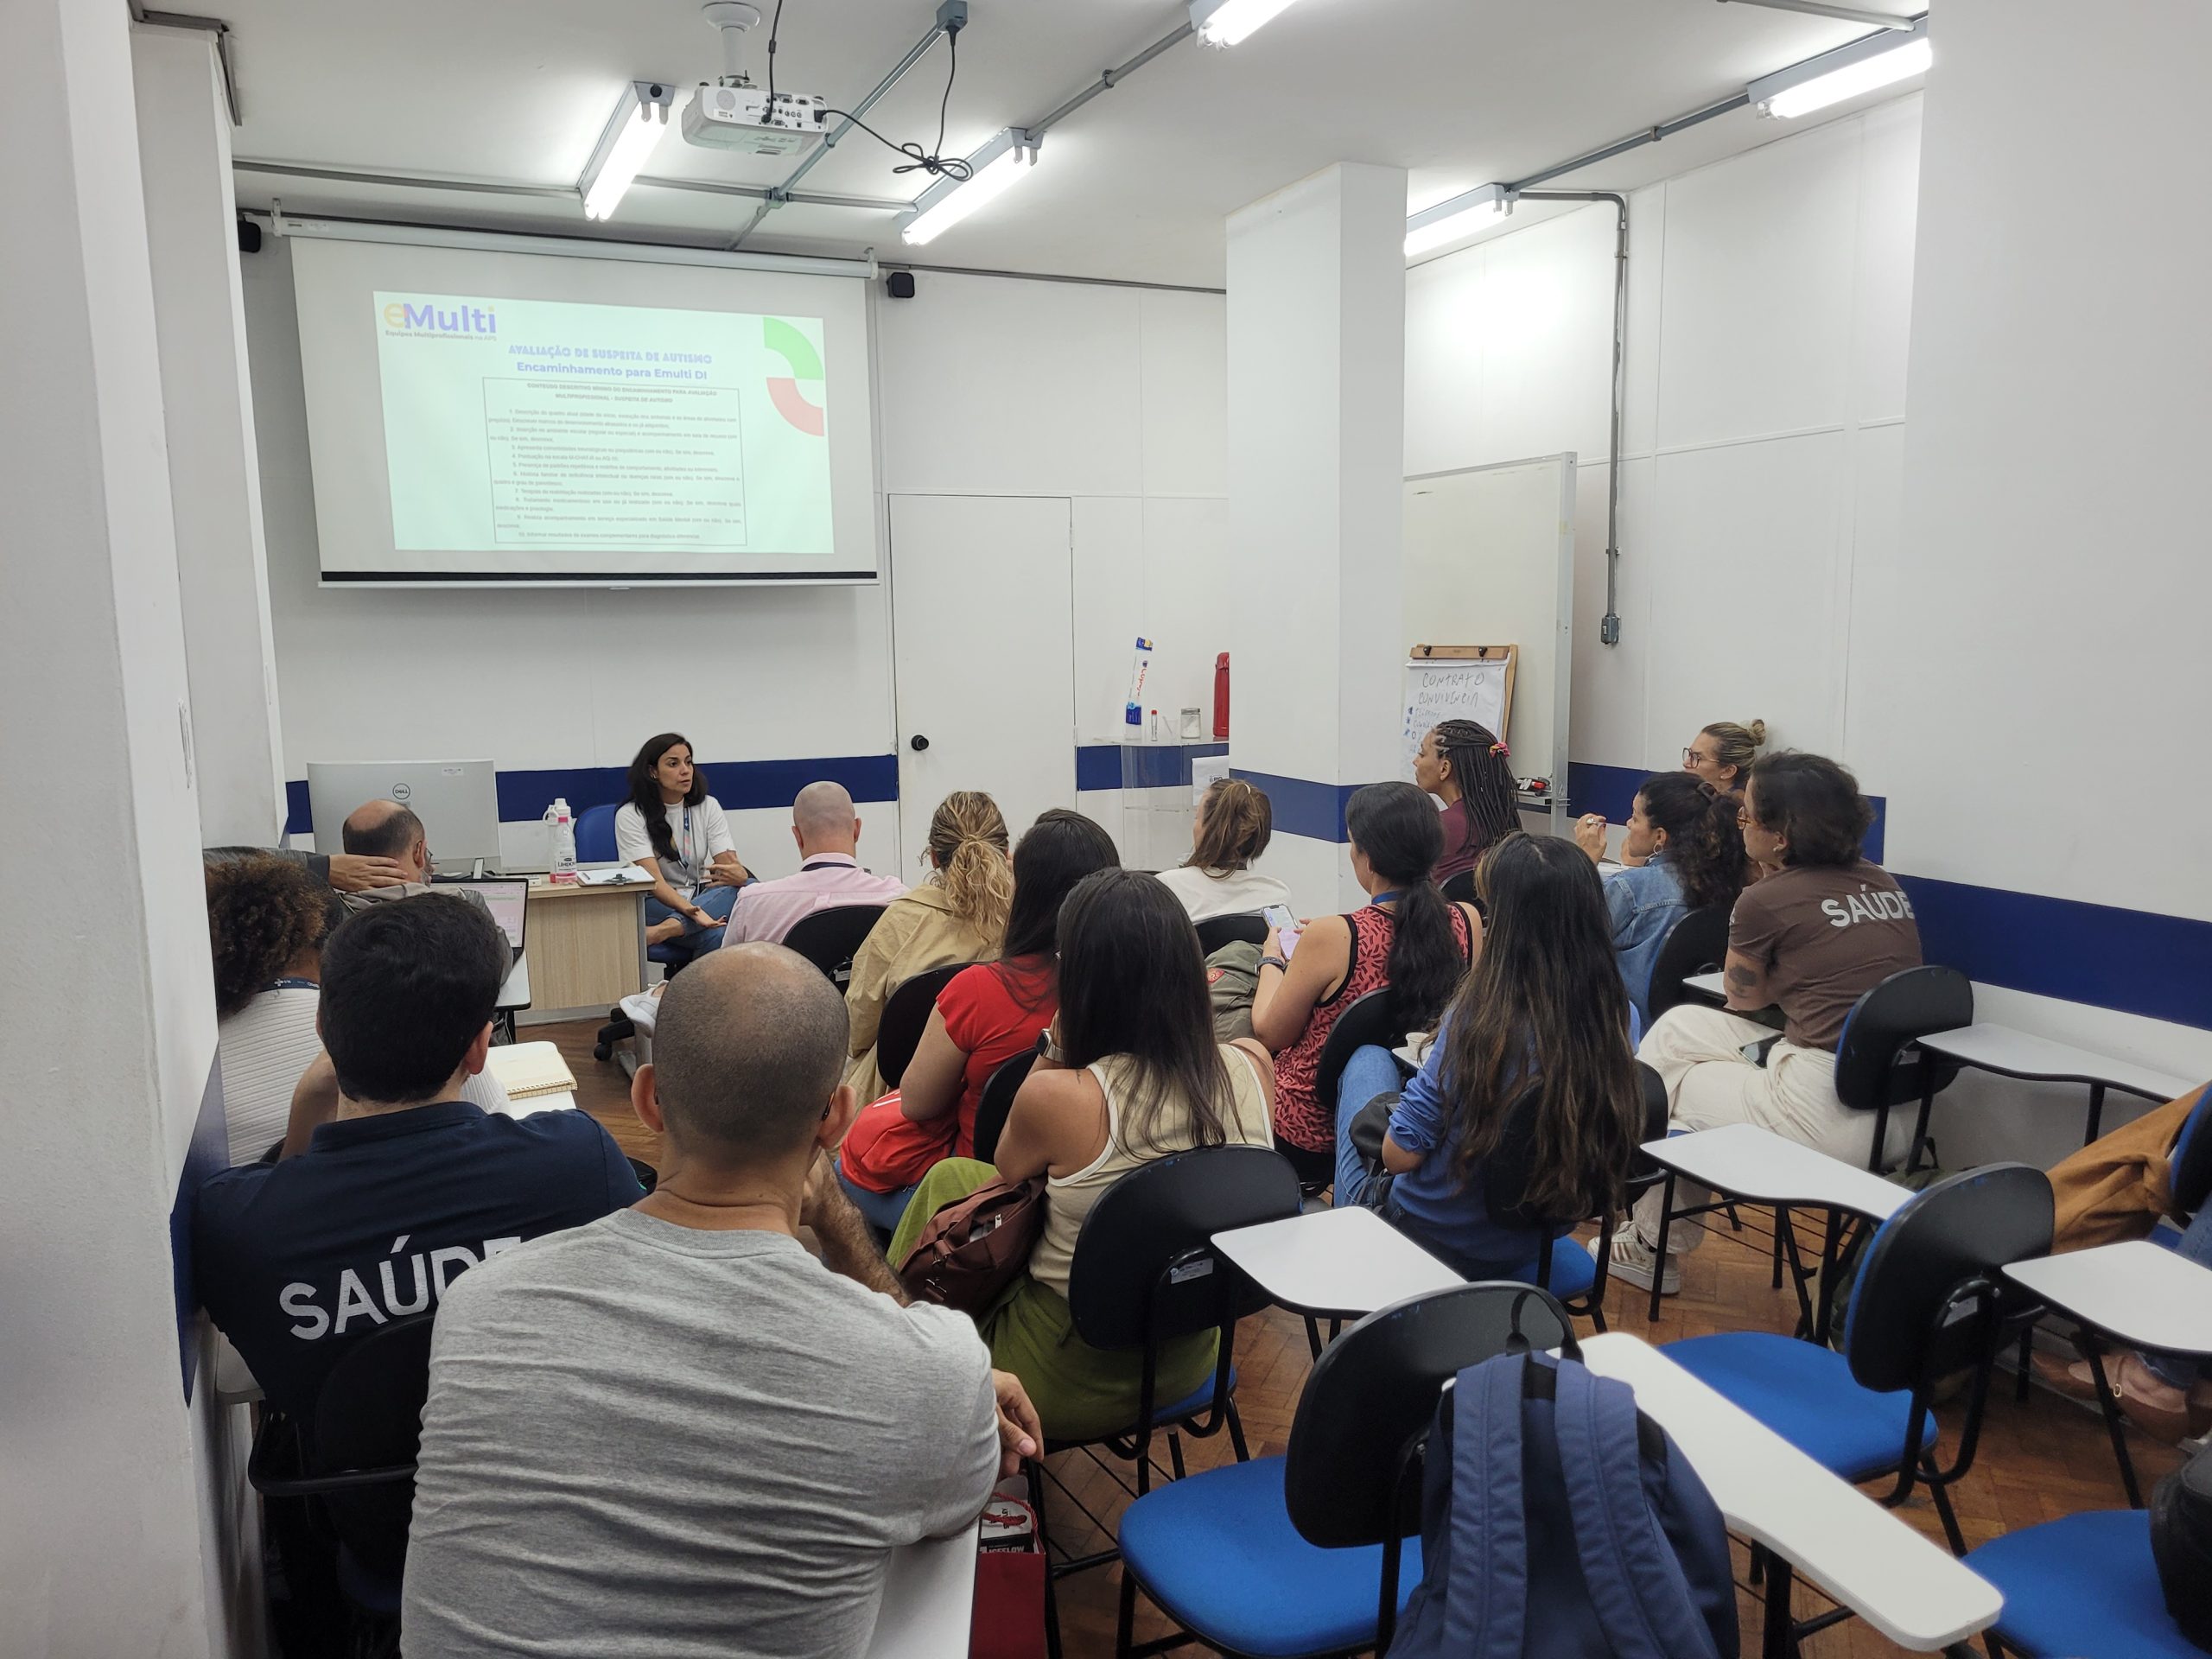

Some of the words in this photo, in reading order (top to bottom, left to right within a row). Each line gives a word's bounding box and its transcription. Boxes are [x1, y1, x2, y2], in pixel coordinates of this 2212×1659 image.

[384, 302, 497, 334] eMulti
[508, 345, 570, 359] AVALIAÇÃO
[575, 347, 590, 358] DE
[593, 348, 643, 360] SUSPEITA
[645, 351, 660, 362] DE
[663, 352, 713, 364] AUTISMO
[517, 361, 623, 377] Encaminhamento
[626, 368, 652, 379] para
[655, 368, 692, 379] Emulti
[695, 370, 708, 380] DI
